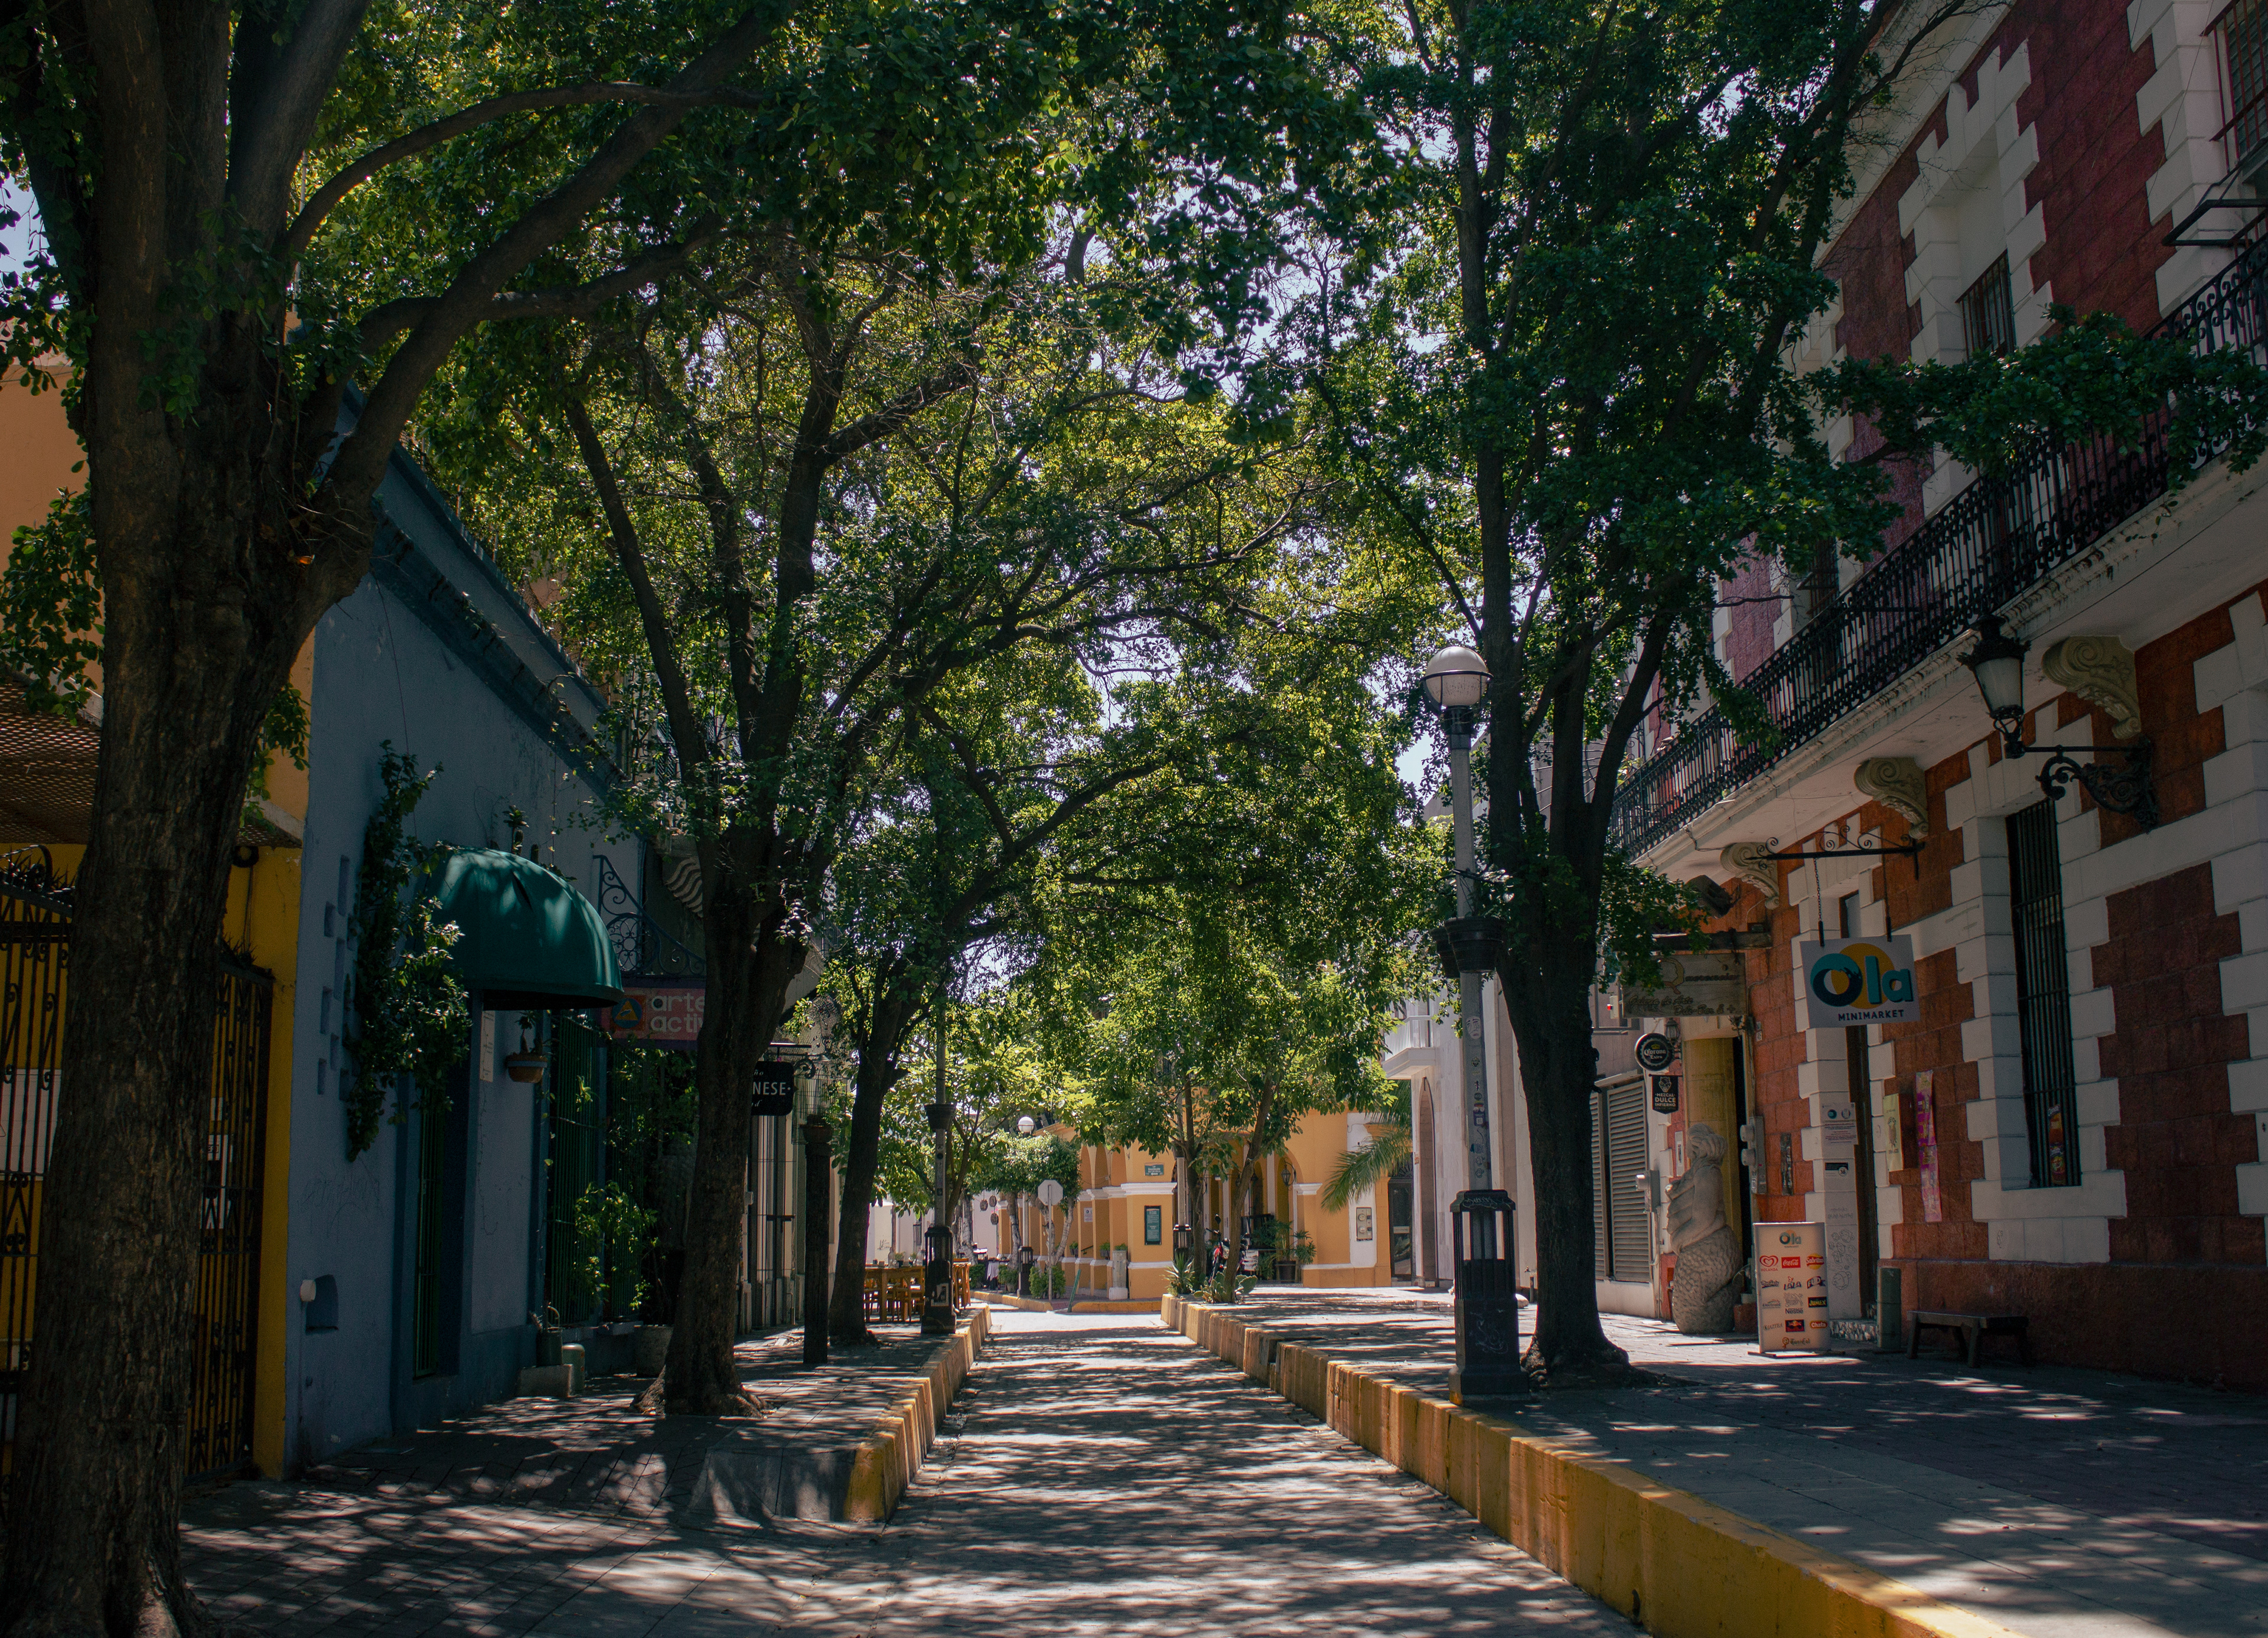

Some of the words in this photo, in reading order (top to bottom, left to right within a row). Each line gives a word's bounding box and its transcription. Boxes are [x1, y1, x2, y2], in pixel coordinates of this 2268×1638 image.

[1810, 953, 1914, 1007] Ola
[1838, 1009, 1904, 1021] MINIMARKET
[752, 1081, 786, 1096] NESE
[1780, 1232, 1801, 1245] Ola
